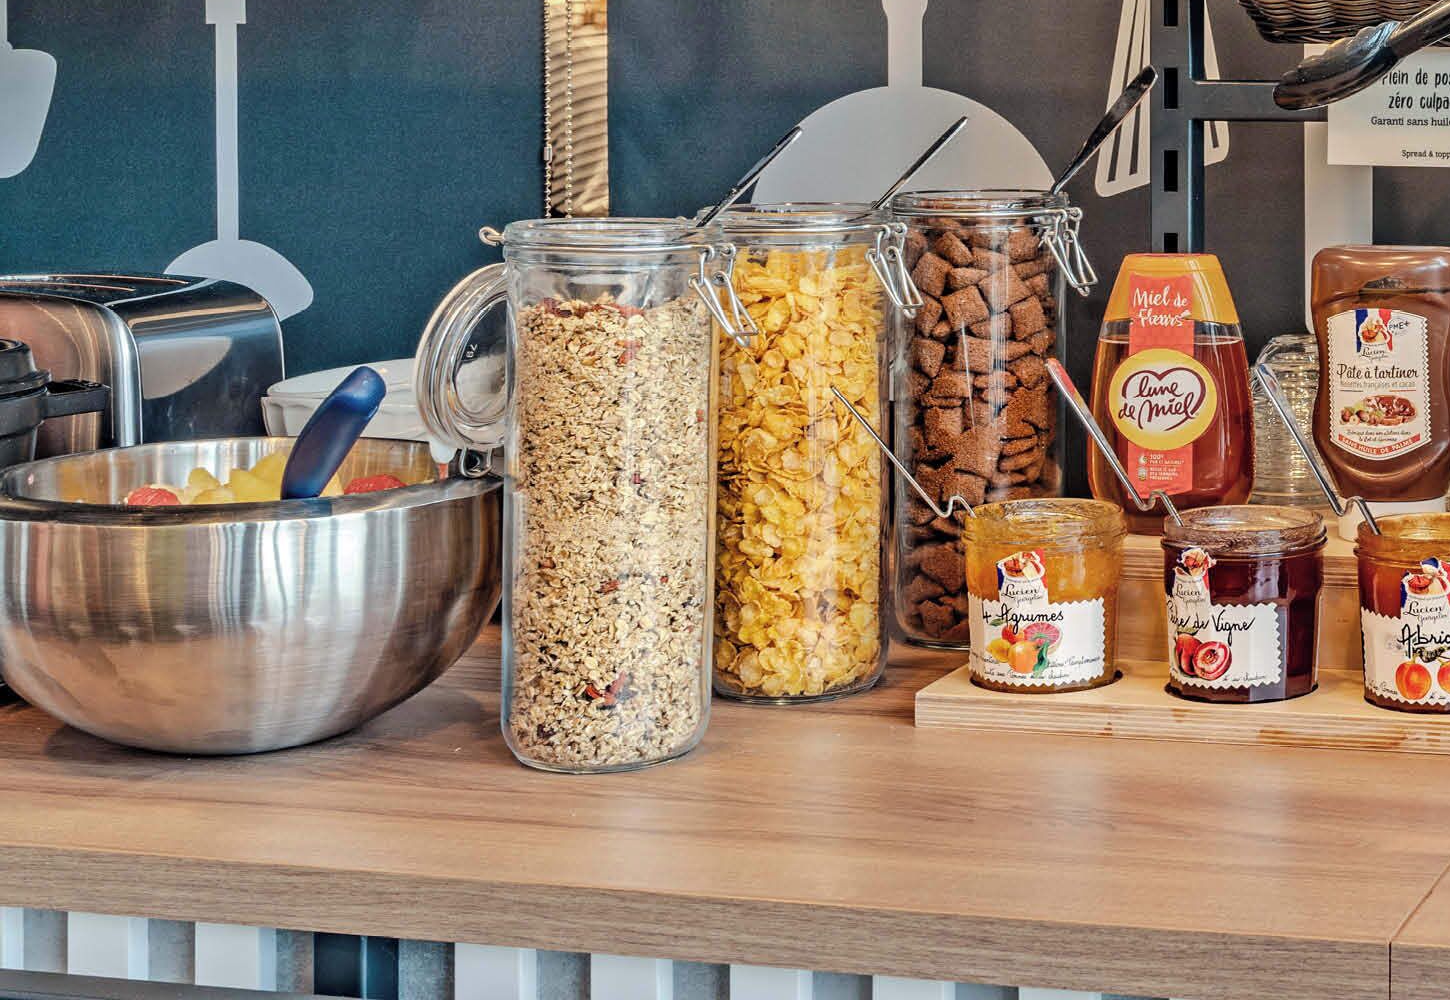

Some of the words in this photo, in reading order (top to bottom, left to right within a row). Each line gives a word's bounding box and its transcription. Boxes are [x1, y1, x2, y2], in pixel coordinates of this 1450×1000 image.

[1415, 68, 1428, 86] de
[1388, 92, 1414, 110] zéro
[1370, 115, 1404, 127] Garanti
[1406, 118, 1429, 127] sans
[1401, 149, 1428, 160] Spread
[1132, 285, 1171, 309] Miel
[1173, 291, 1189, 307] de
[1336, 363, 1362, 380] Pâte
[1364, 366, 1373, 379] à
[1374, 364, 1420, 379] tartiner
[1131, 374, 1185, 400] lune
[1117, 400, 1137, 421] de
[1137, 391, 1197, 432] miel
[1000, 583, 1041, 599] Lucien
[1173, 583, 1203, 599] Lucien
[1402, 600, 1446, 617] Lucien
[995, 603, 1065, 635] Agrumes
[1211, 608, 1256, 648] Vigne
